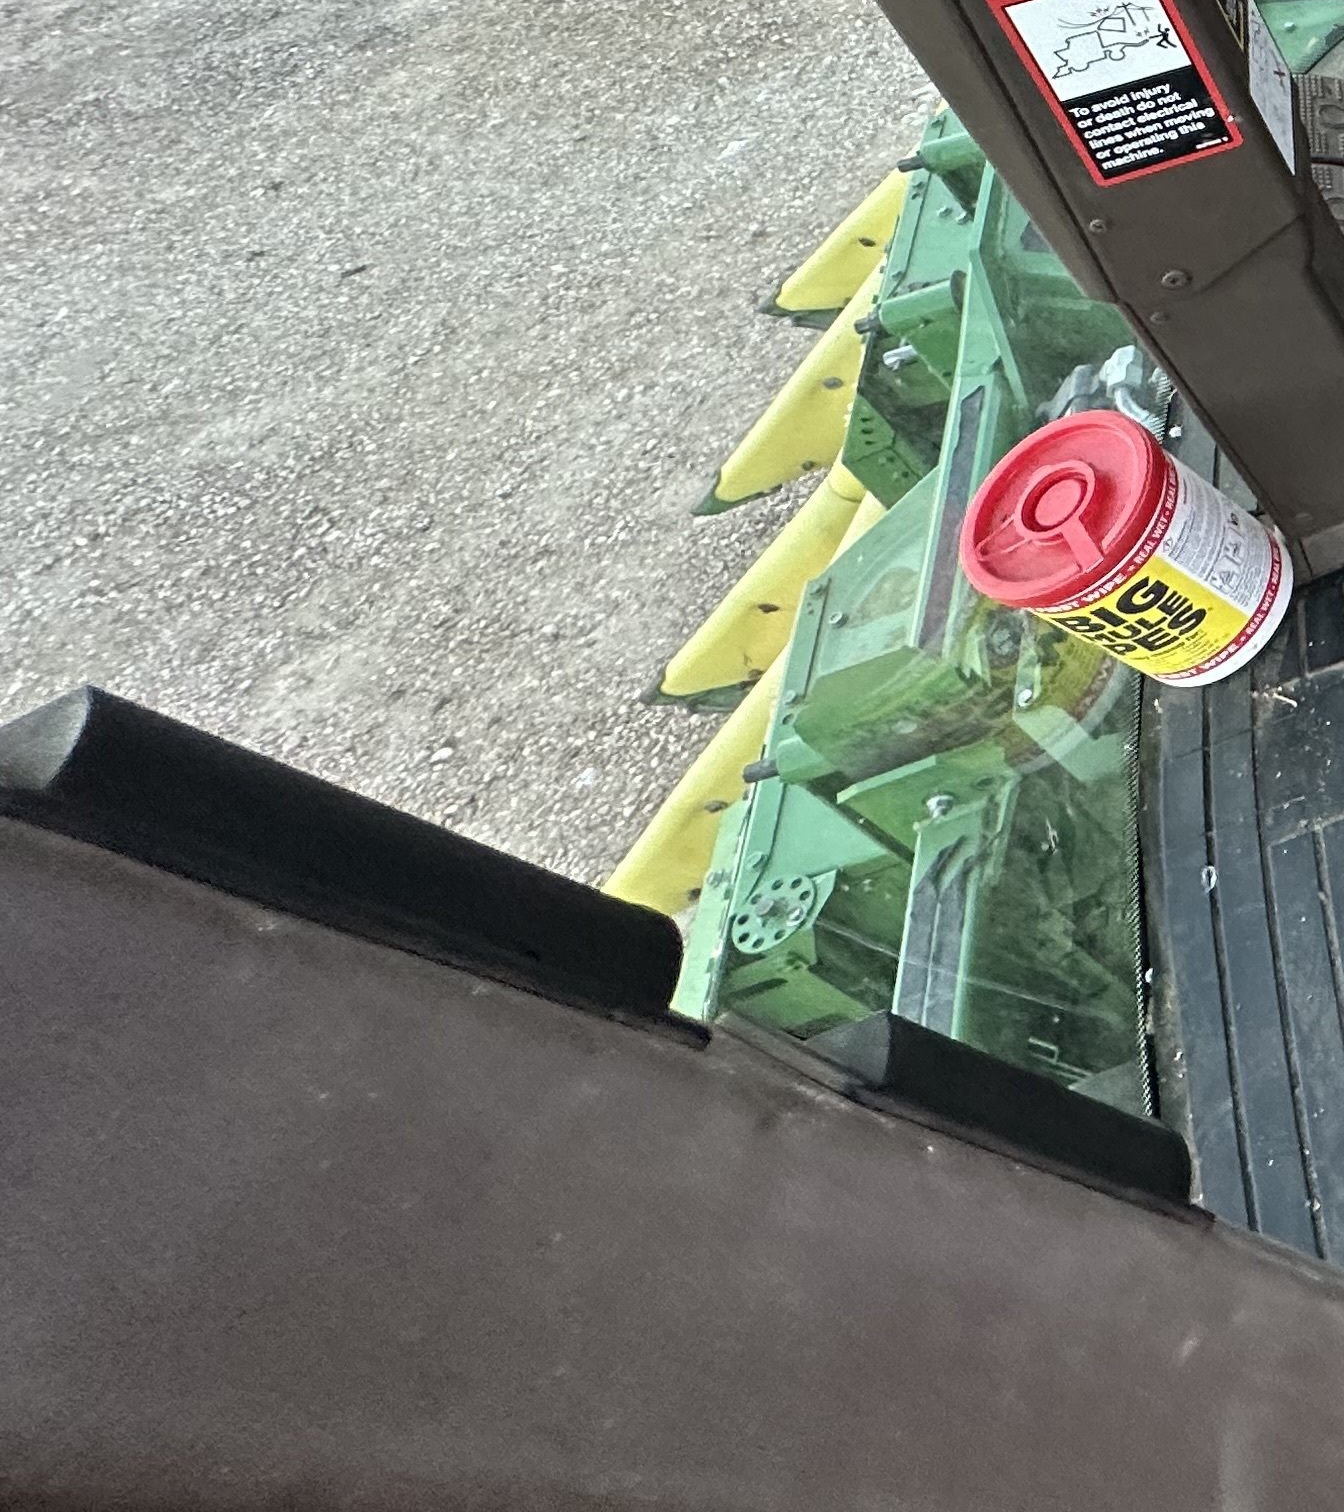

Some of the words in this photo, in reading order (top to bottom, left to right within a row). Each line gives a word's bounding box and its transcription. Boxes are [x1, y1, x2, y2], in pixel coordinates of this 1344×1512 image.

[1069, 107, 1090, 118] To
[1091, 94, 1130, 113] avoid
[1131, 83, 1171, 102] injury
[1077, 118, 1093, 129] or
[1095, 105, 1135, 123] death
[1136, 100, 1156, 112] do
[1157, 91, 1182, 105] not
[1083, 119, 1136, 139] contact
[1136, 98, 1198, 123] electrical
[1089, 133, 1124, 150] lines
[1124, 122, 1164, 140] when
[1163, 107, 1215, 128] moving
[1095, 148, 1111, 160] or
[1113, 129, 1179, 155] operating
[1178, 121, 1206, 135] this
[1101, 146, 1165, 170] machine.
[1080, 573, 1127, 602] WIPE
[1133, 540, 1158, 565] REAL
[1152, 514, 1168, 539] WET
[1050, 576, 1177, 634] BIG
[1081, 590, 1190, 645] MULE
[1100, 606, 1208, 656] PES
[1199, 642, 1240, 671] WIPE
[1245, 613, 1265, 635] REAL
